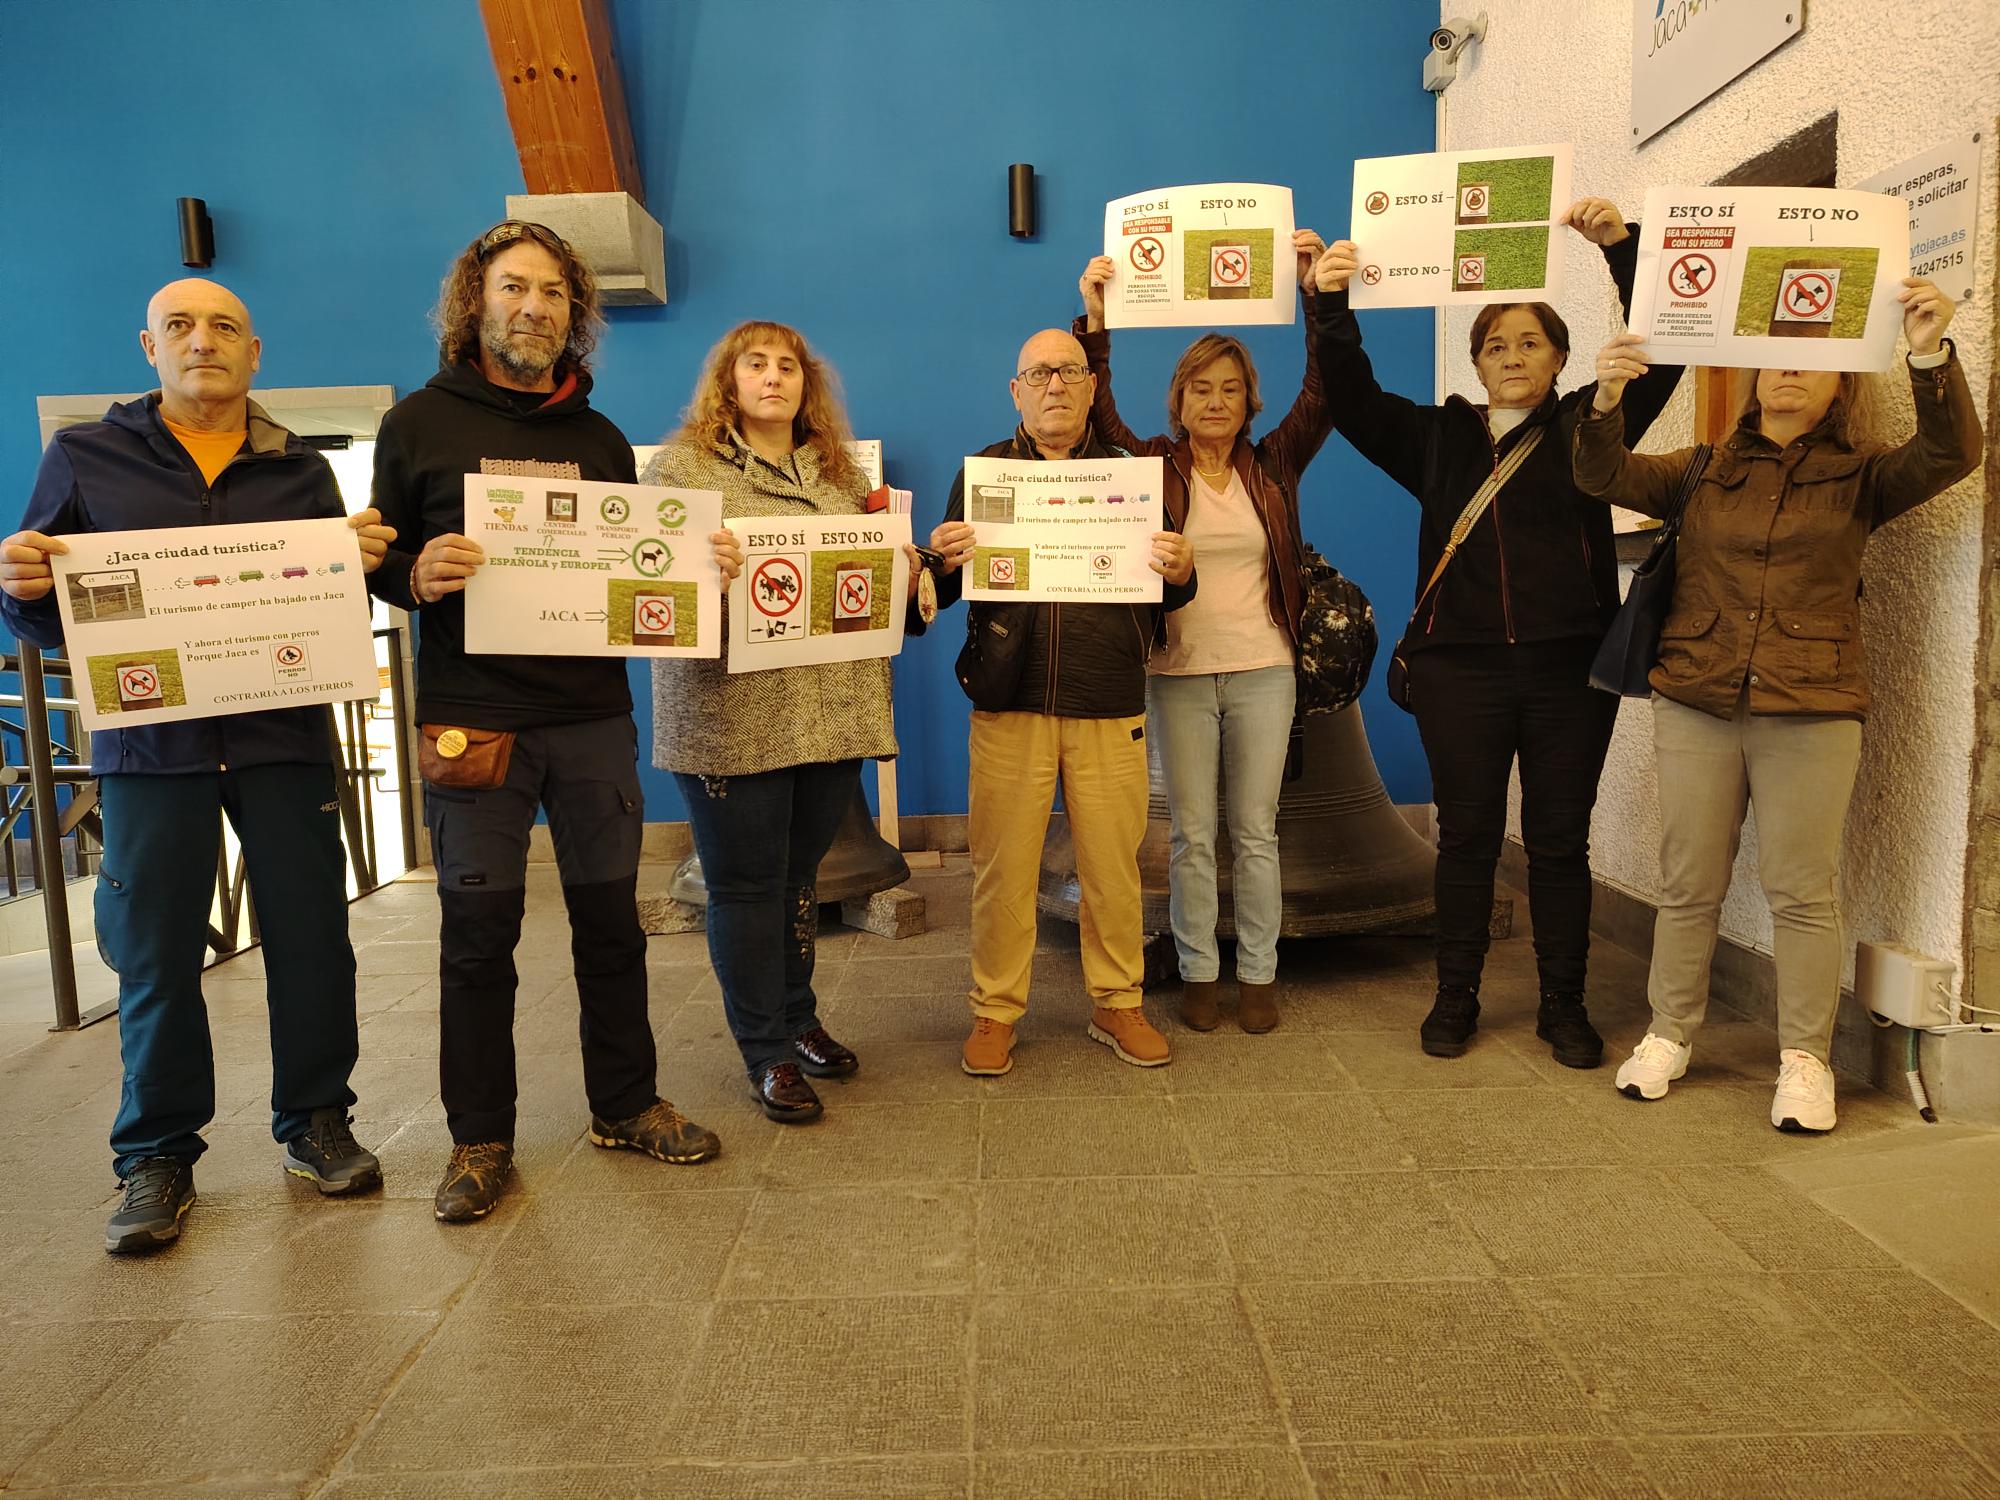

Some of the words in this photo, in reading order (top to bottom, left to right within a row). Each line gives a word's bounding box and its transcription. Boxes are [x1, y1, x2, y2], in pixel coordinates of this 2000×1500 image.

[1906, 163, 1957, 192] esperas,
[1395, 194, 1428, 206] ESTO
[1431, 191, 1444, 204] SÍ
[1918, 178, 1968, 207] solicitar
[1124, 203, 1154, 215] ESTO
[1158, 199, 1169, 210] SÍ
[1200, 199, 1234, 210] ESTO
[1237, 198, 1257, 208] NO
[1668, 206, 1713, 218] ESTO
[1718, 202, 1736, 218] SÍ
[1778, 208, 1827, 220] ESTO
[1830, 208, 1859, 221] NO
[1665, 228, 1681, 237] SEA
[1681, 228, 1734, 237] RESPONSABLE
[1671, 239, 1687, 248] CON
[1688, 239, 1699, 248] SU
[1700, 239, 1724, 248] PERRO
[1388, 267, 1418, 277] ESTO
[1422, 266, 1440, 275] NO
[997, 473, 1024, 483] ¿Jaca
[1026, 474, 1062, 483] ciudad
[1064, 473, 1113, 482] turística?
[484, 522, 528, 532] TIENDAS
[748, 534, 787, 547] ESTO
[791, 530, 805, 545] SÍ
[821, 532, 858, 545] ESTO
[862, 531, 884, 543] NO
[106, 550, 150, 565] ¿Jaca
[155, 545, 209, 559] ciudad
[214, 540, 286, 555] turística?
[513, 547, 581, 558] TENDENCIA
[489, 557, 549, 568] ESPAÑOLA
[551, 562, 558, 570] y
[560, 561, 612, 570] EUROPEA
[150, 606, 161, 616] El
[164, 604, 203, 615] turismo
[206, 602, 218, 611] de
[220, 599, 256, 612] camper
[260, 597, 271, 606] ha
[274, 594, 307, 607] bajado
[323, 592, 345, 600] Jaca
[539, 610, 580, 621] JACA
[184, 640, 192, 649] Y
[194, 638, 222, 648] ahora
[224, 636, 233, 645] el
[235, 634, 271, 644] turismo
[272, 632, 289, 641] con
[291, 629, 320, 641] perros
[186, 652, 223, 663] Porque
[225, 650, 247, 659] Jaca
[213, 690, 278, 704] CONTRARIA
[290, 685, 310, 695] LOS
[312, 680, 354, 692] PERROS
